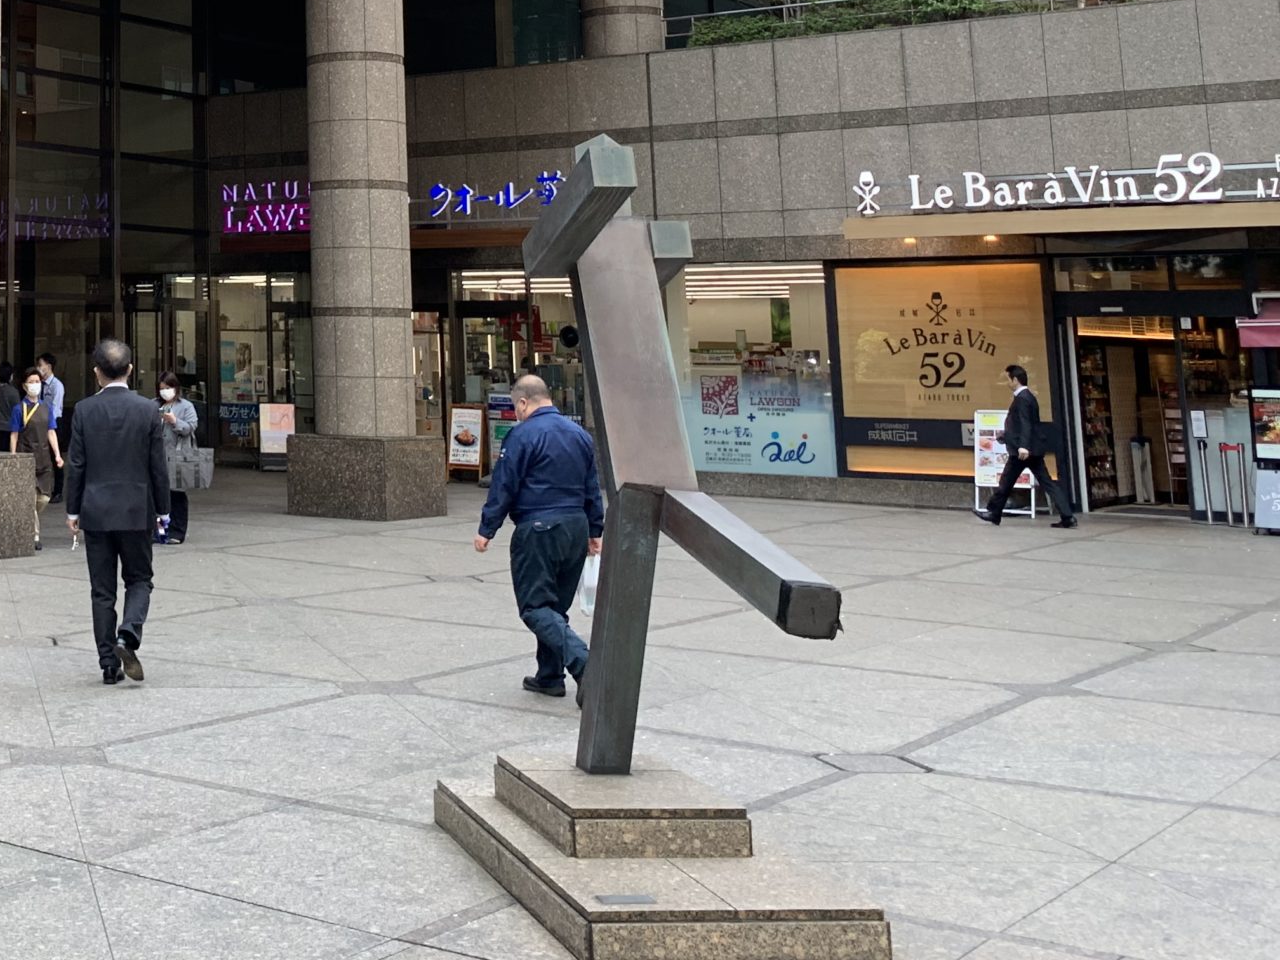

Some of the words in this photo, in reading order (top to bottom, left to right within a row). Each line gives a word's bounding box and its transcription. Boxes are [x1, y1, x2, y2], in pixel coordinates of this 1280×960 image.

[907, 174, 954, 210] Le
[962, 171, 1034, 207] Bar
[1063, 164, 1141, 203] Vin
[1152, 151, 1223, 203] 52
[223, 181, 310, 202] NATU
[882, 337, 911, 356] Le
[911, 327, 950, 347] Bar
[966, 328, 997, 357] Vin
[918, 351, 967, 389] 52
[749, 396, 801, 407] LAWSON
[219, 406, 259, 419] 処方せん
[229, 422, 250, 436] 受付
